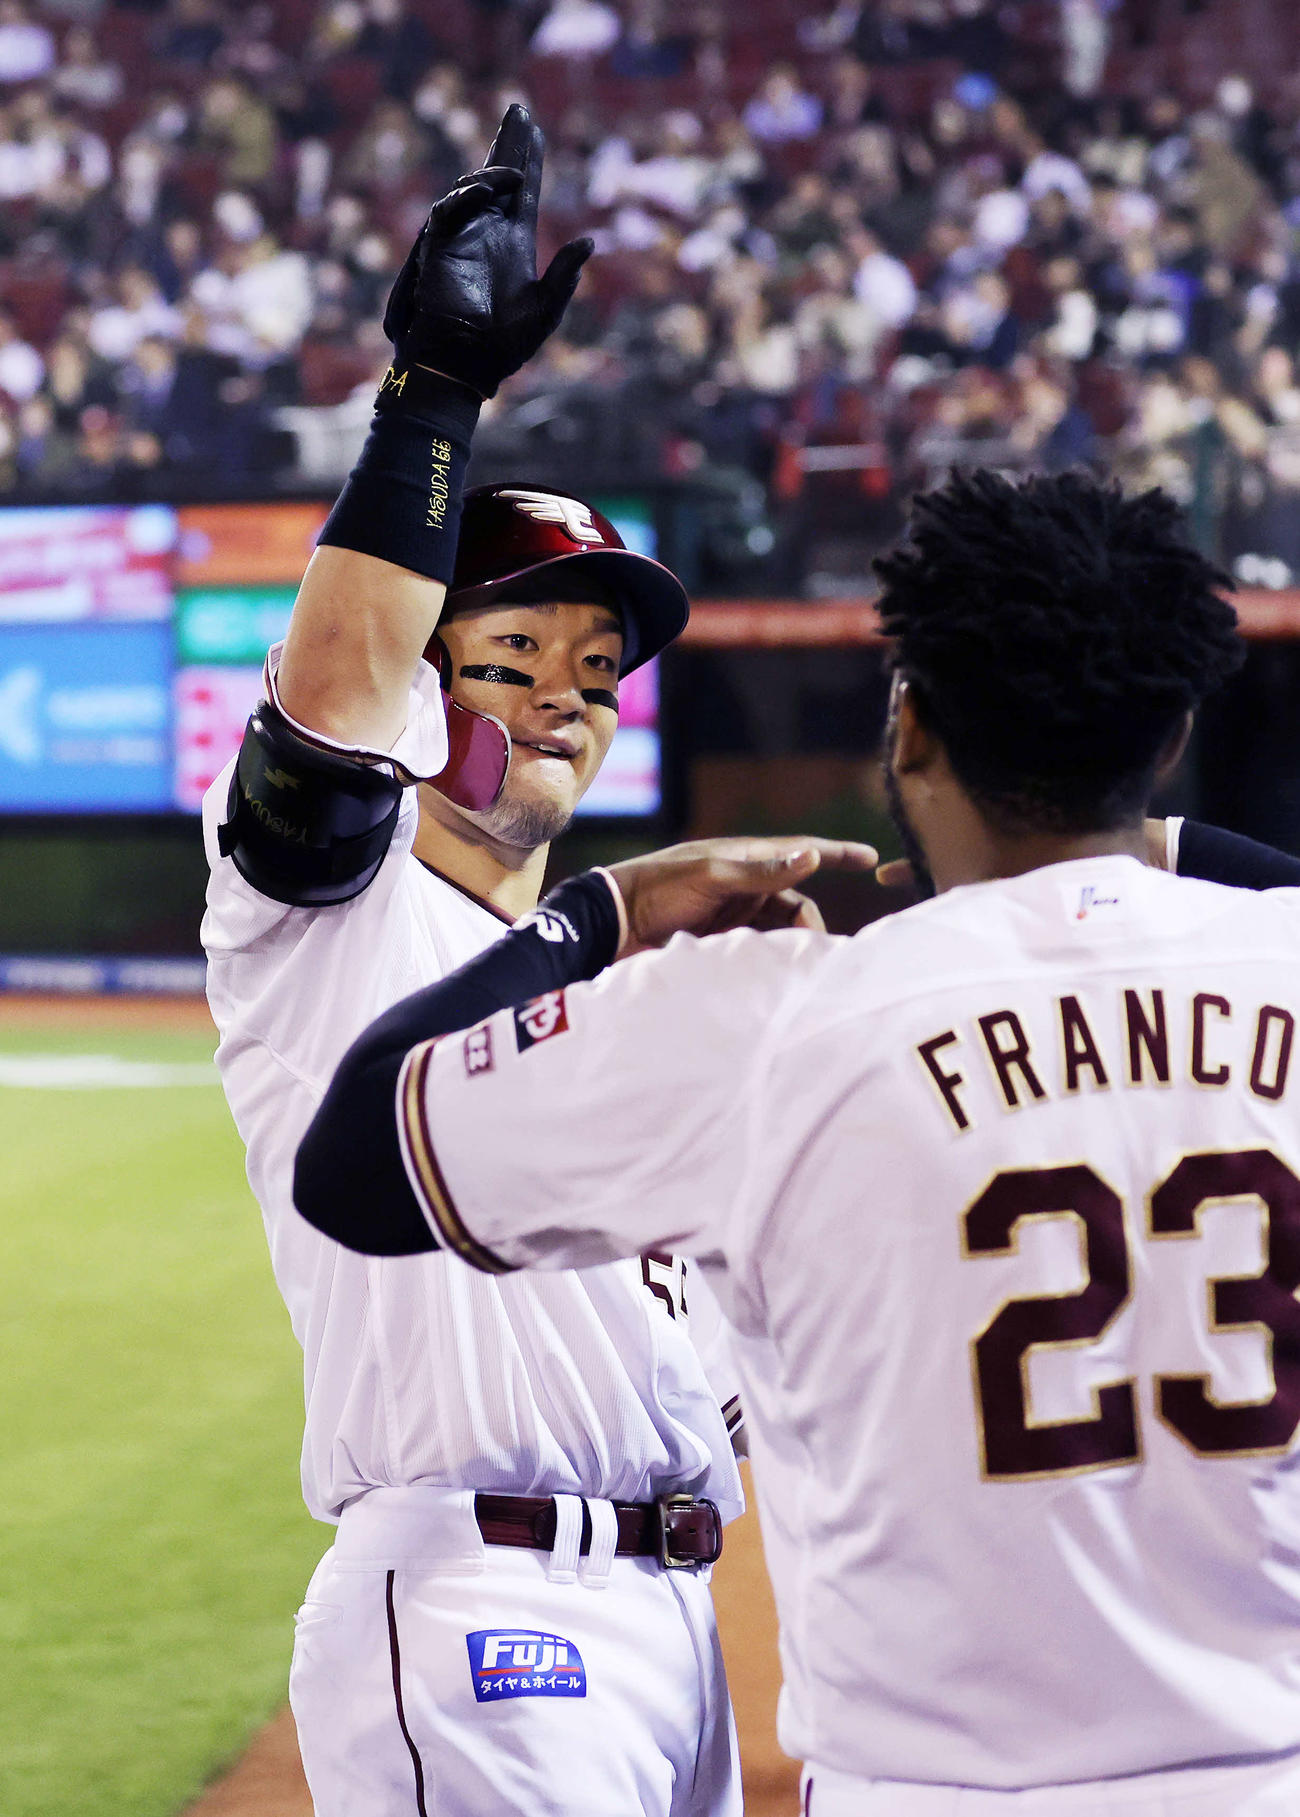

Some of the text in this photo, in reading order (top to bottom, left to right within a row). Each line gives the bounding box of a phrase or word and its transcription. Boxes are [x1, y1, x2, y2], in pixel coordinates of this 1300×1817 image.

[426, 463, 451, 530] YASUDA
[914, 986, 1297, 1134] FRANCO
[959, 1145, 1300, 1484] 23
[480, 1675, 581, 1694] タイヤ&ホイール
[481, 1634, 569, 1673] Fuji
